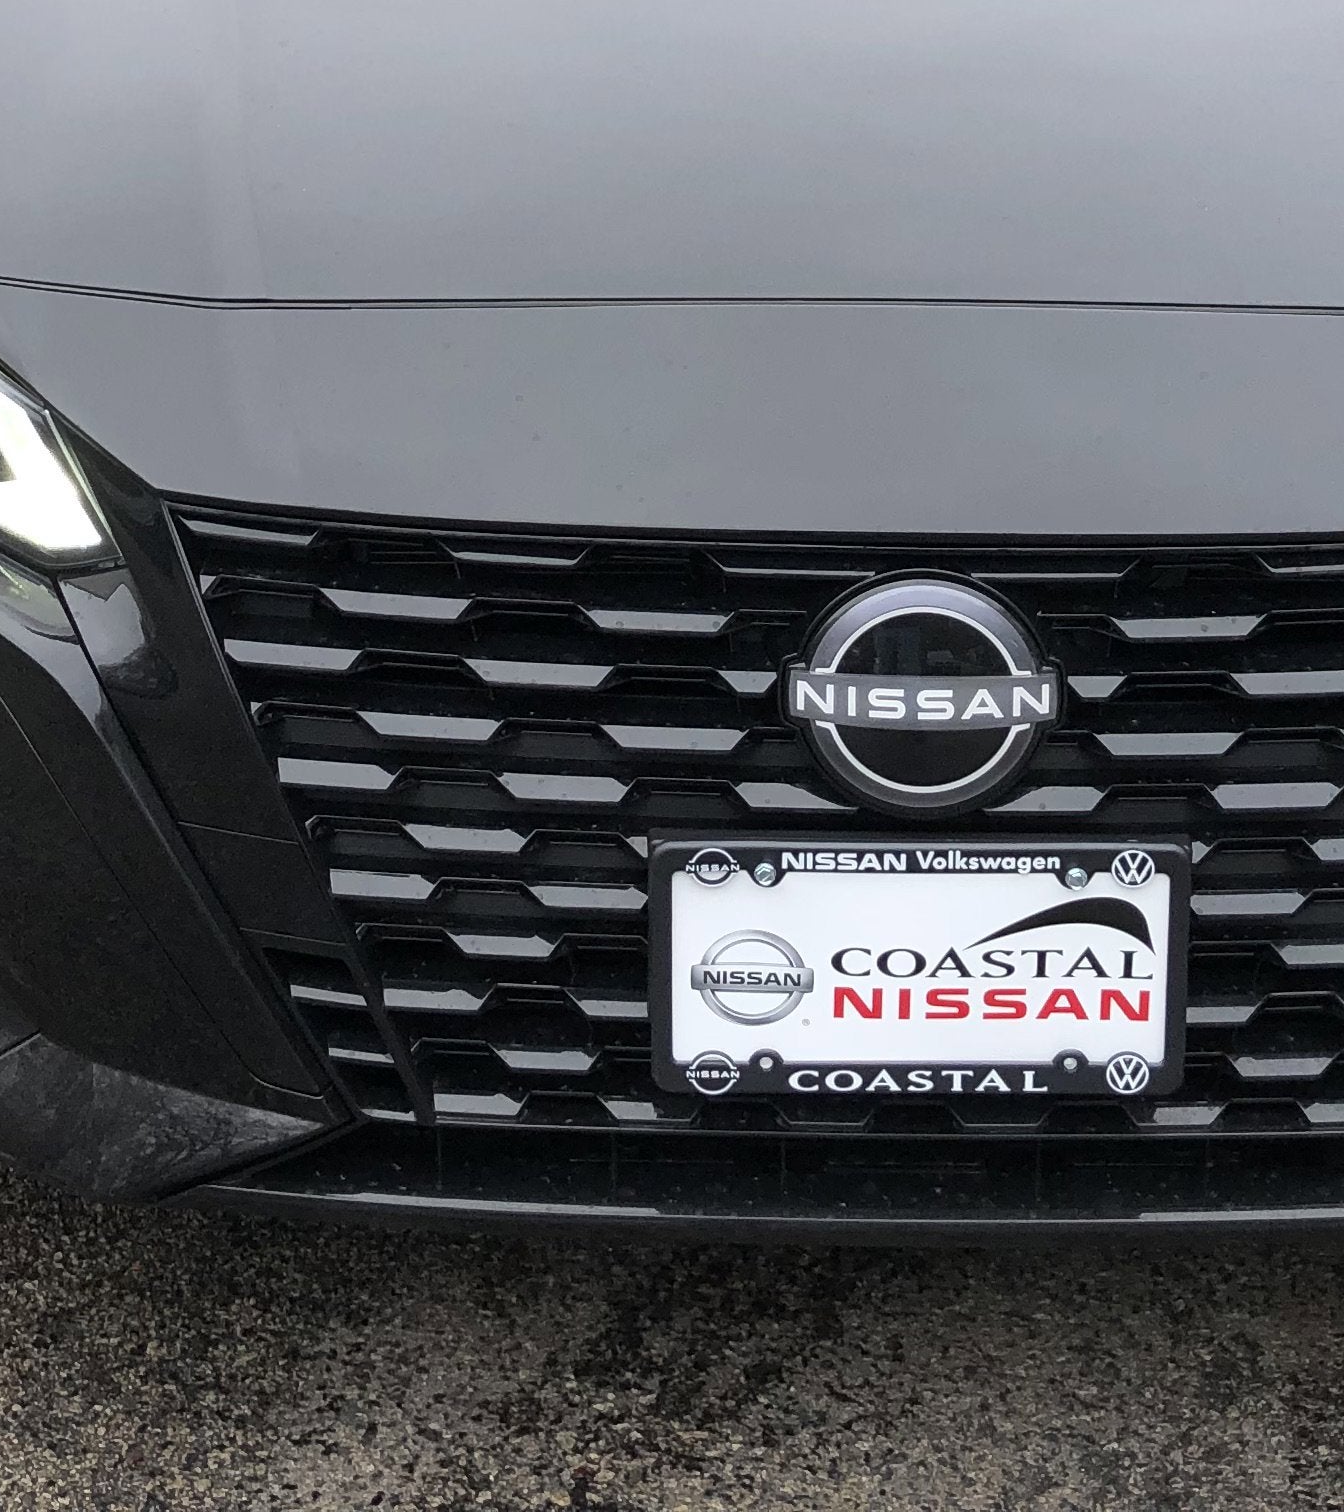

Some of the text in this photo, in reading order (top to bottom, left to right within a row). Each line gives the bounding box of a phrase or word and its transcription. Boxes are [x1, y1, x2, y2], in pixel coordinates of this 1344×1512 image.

[795, 679, 1050, 720] NISSAN
[685, 864, 739, 872] NISSAN
[782, 851, 1060, 874] NISSAN Volkswagen
[831, 947, 1154, 979] COASTAL
[704, 970, 801, 987] NISSAN
[833, 987, 1151, 1021] NISSAN
[686, 1070, 739, 1079] NISSAN
[788, 1069, 1048, 1092] COASTAL
